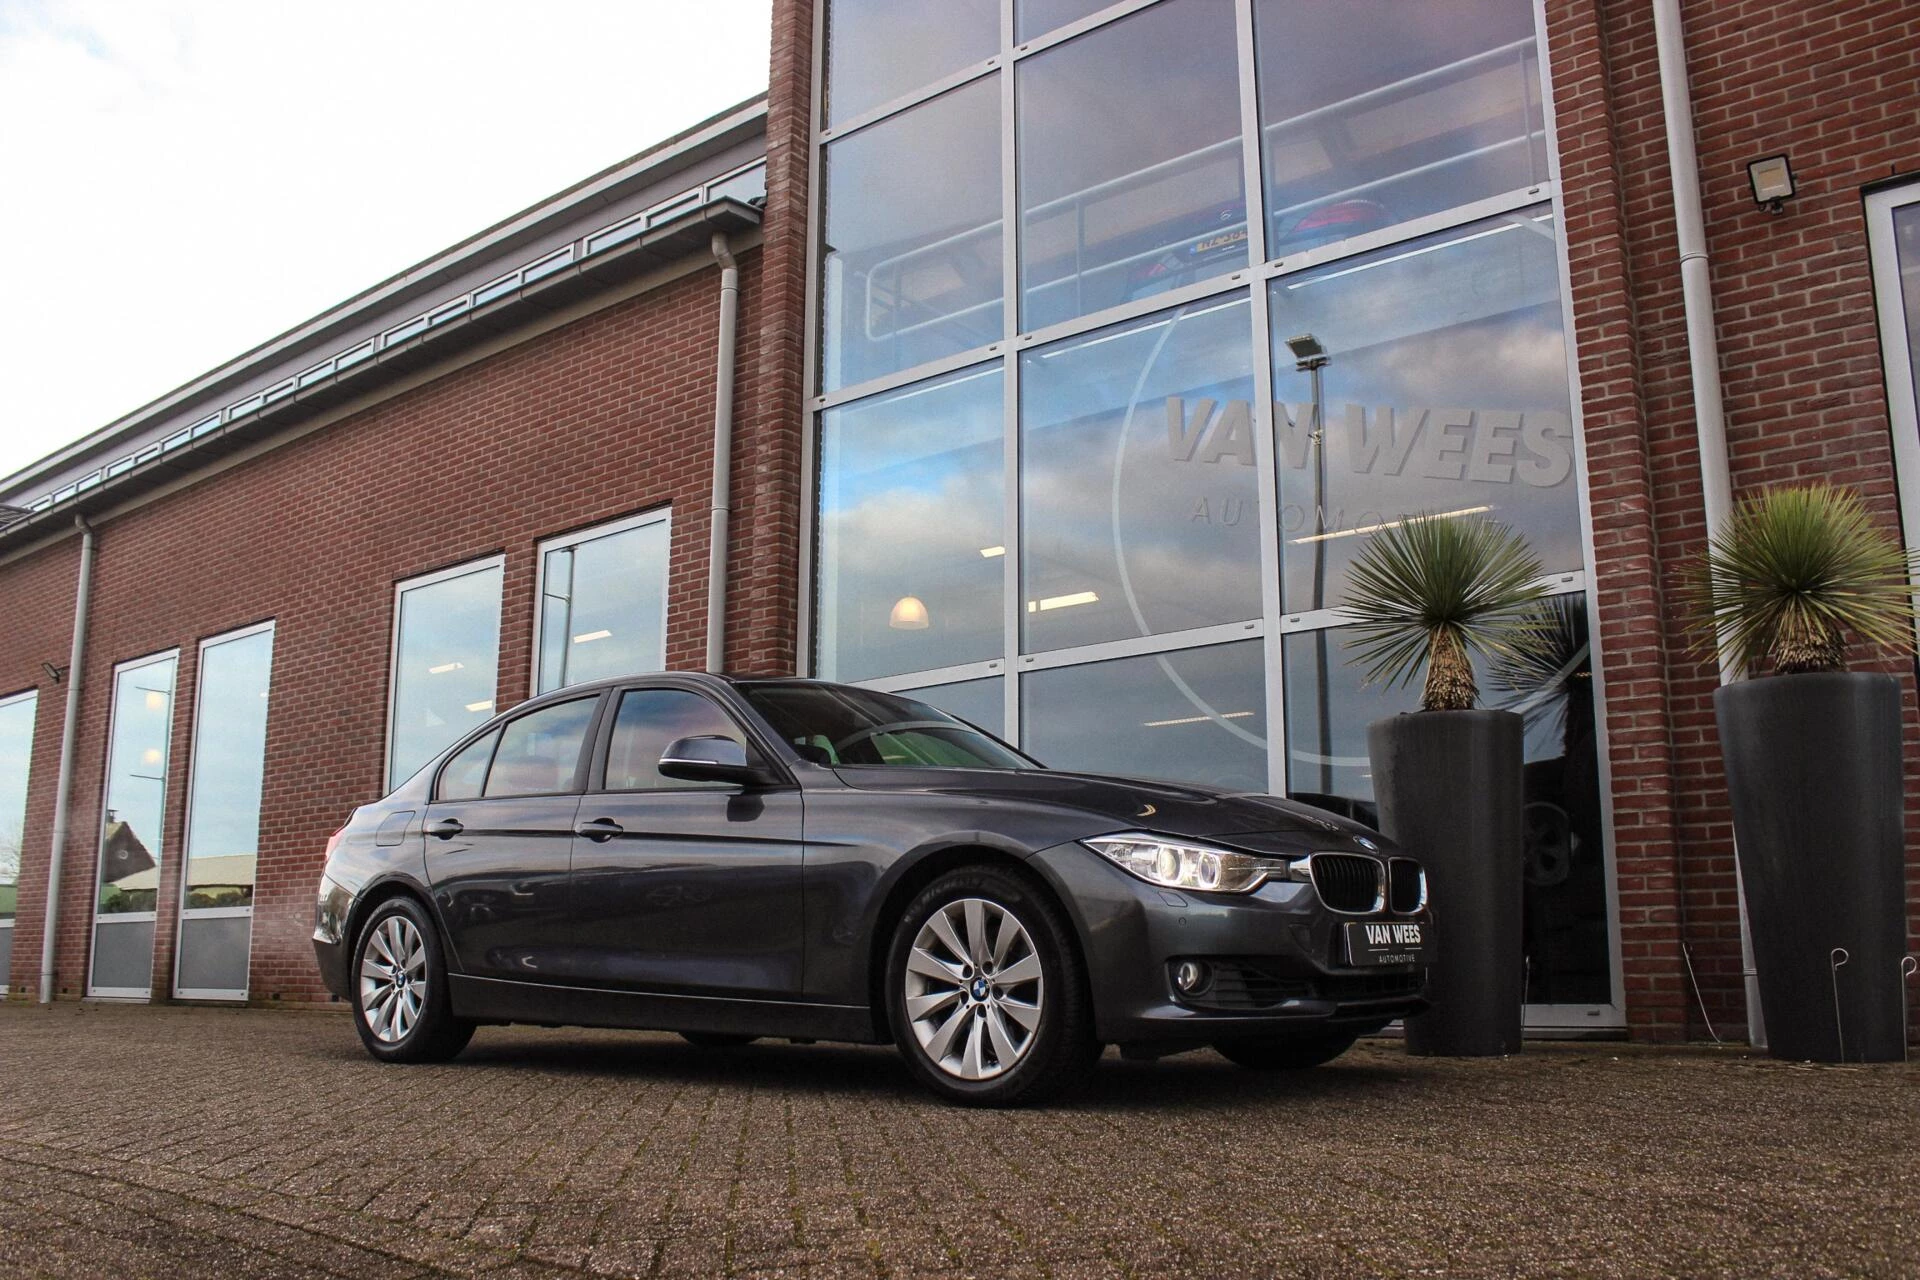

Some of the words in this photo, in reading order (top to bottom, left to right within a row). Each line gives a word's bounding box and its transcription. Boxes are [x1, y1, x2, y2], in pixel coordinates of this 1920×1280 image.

[1167, 397, 1318, 469] VAN
[1345, 404, 1573, 488] WEES
[1365, 924, 1391, 944] VAN
[1392, 924, 1421, 943] WEES
[1379, 954, 1415, 963] AUTOMOTIVE
